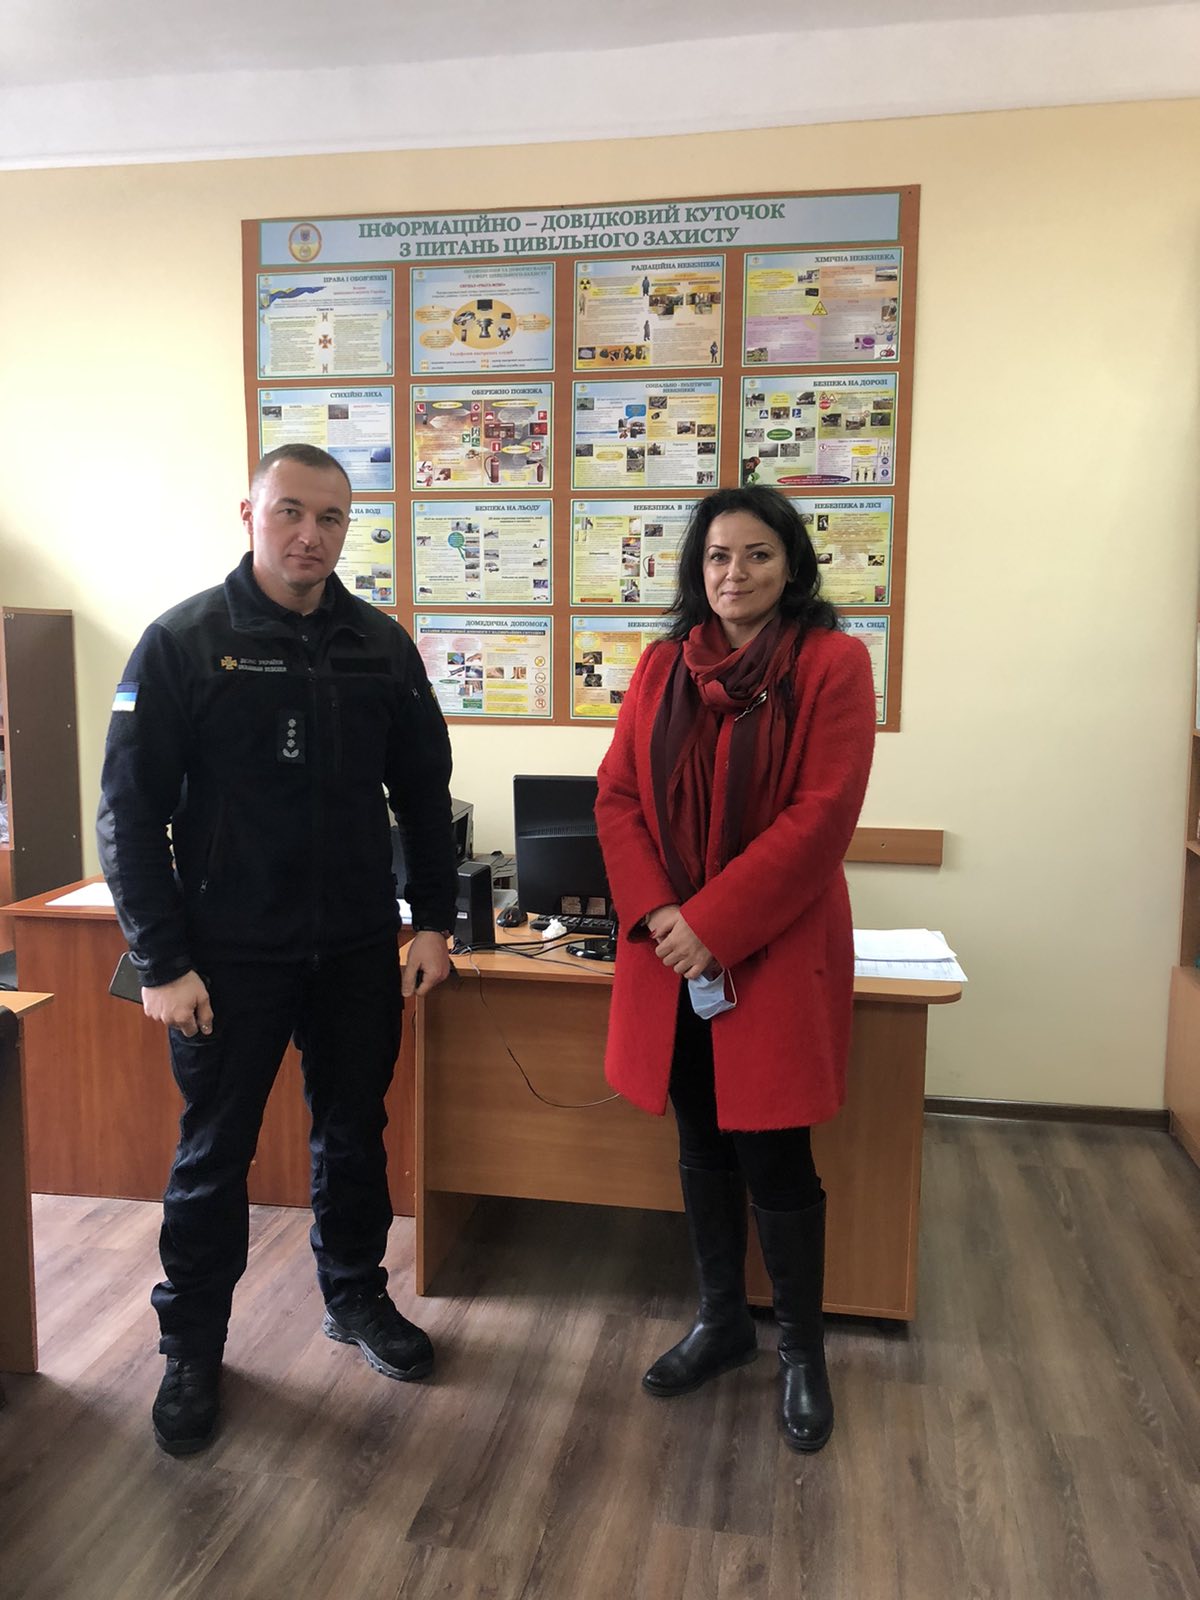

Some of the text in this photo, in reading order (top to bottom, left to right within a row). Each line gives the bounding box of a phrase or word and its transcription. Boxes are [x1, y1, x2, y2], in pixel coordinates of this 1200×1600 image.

[358, 214, 521, 238] ІНФОРМАЦІЙНО
[541, 205, 680, 232] ДОВІДКОВИЙ
[685, 203, 785, 222] КУТОЧОК
[400, 227, 740, 257] З ПИТАНЬ ЦИВІЛЬНОГО ЗАХИСТУ
[814, 253, 895, 263] ХІМІЧНА НЕБЕЗПЕКА
[631, 261, 720, 271] РАДІАЦІЙНА НЕБЕЗПЕКА
[860, 379, 888, 387] ДОРОЗІ
[471, 388, 509, 396] ОБЕРЕЖНО
[517, 504, 541, 512] ЛЬОДУ
[510, 620, 548, 628] ДОПОМОГА
